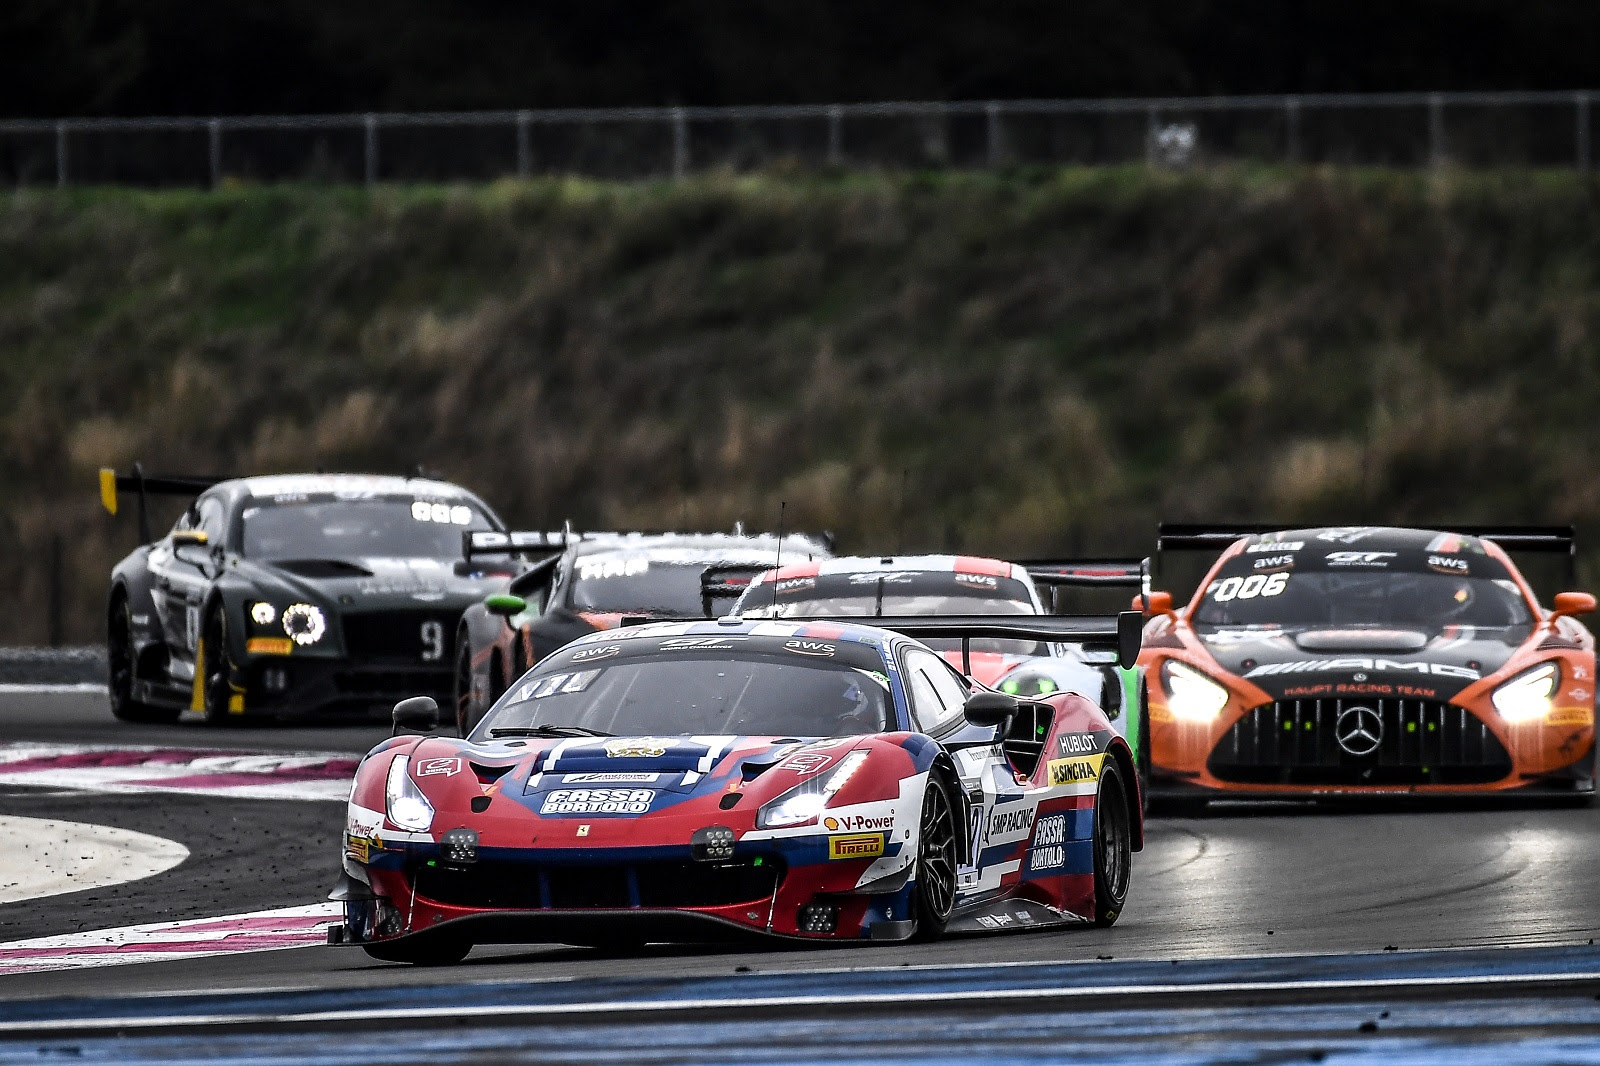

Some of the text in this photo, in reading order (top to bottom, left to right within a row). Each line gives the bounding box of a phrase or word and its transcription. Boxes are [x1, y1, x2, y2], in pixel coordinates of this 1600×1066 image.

[1253, 554, 1294, 568] aws
[1427, 555, 1468, 569] aws
[954, 573, 997, 586] aws
[1214, 572, 1290, 602] 006
[420, 621, 444, 659] 9
[785, 640, 837, 653] aws
[572, 644, 622, 660] aws
[1285, 683, 1436, 697] HAUPT RACING TEAM
[1060, 734, 1098, 754] HUBLOT
[1059, 762, 1097, 783] SINGHA
[545, 789, 655, 803] FASSA
[541, 802, 649, 814] BORTOLO
[840, 816, 894, 831] V-Power
[990, 807, 1034, 836] SMP RACING
[1034, 815, 1065, 846] FASSA
[834, 837, 880, 855] PIRELLI
[1031, 845, 1065, 870] BORTOLO
